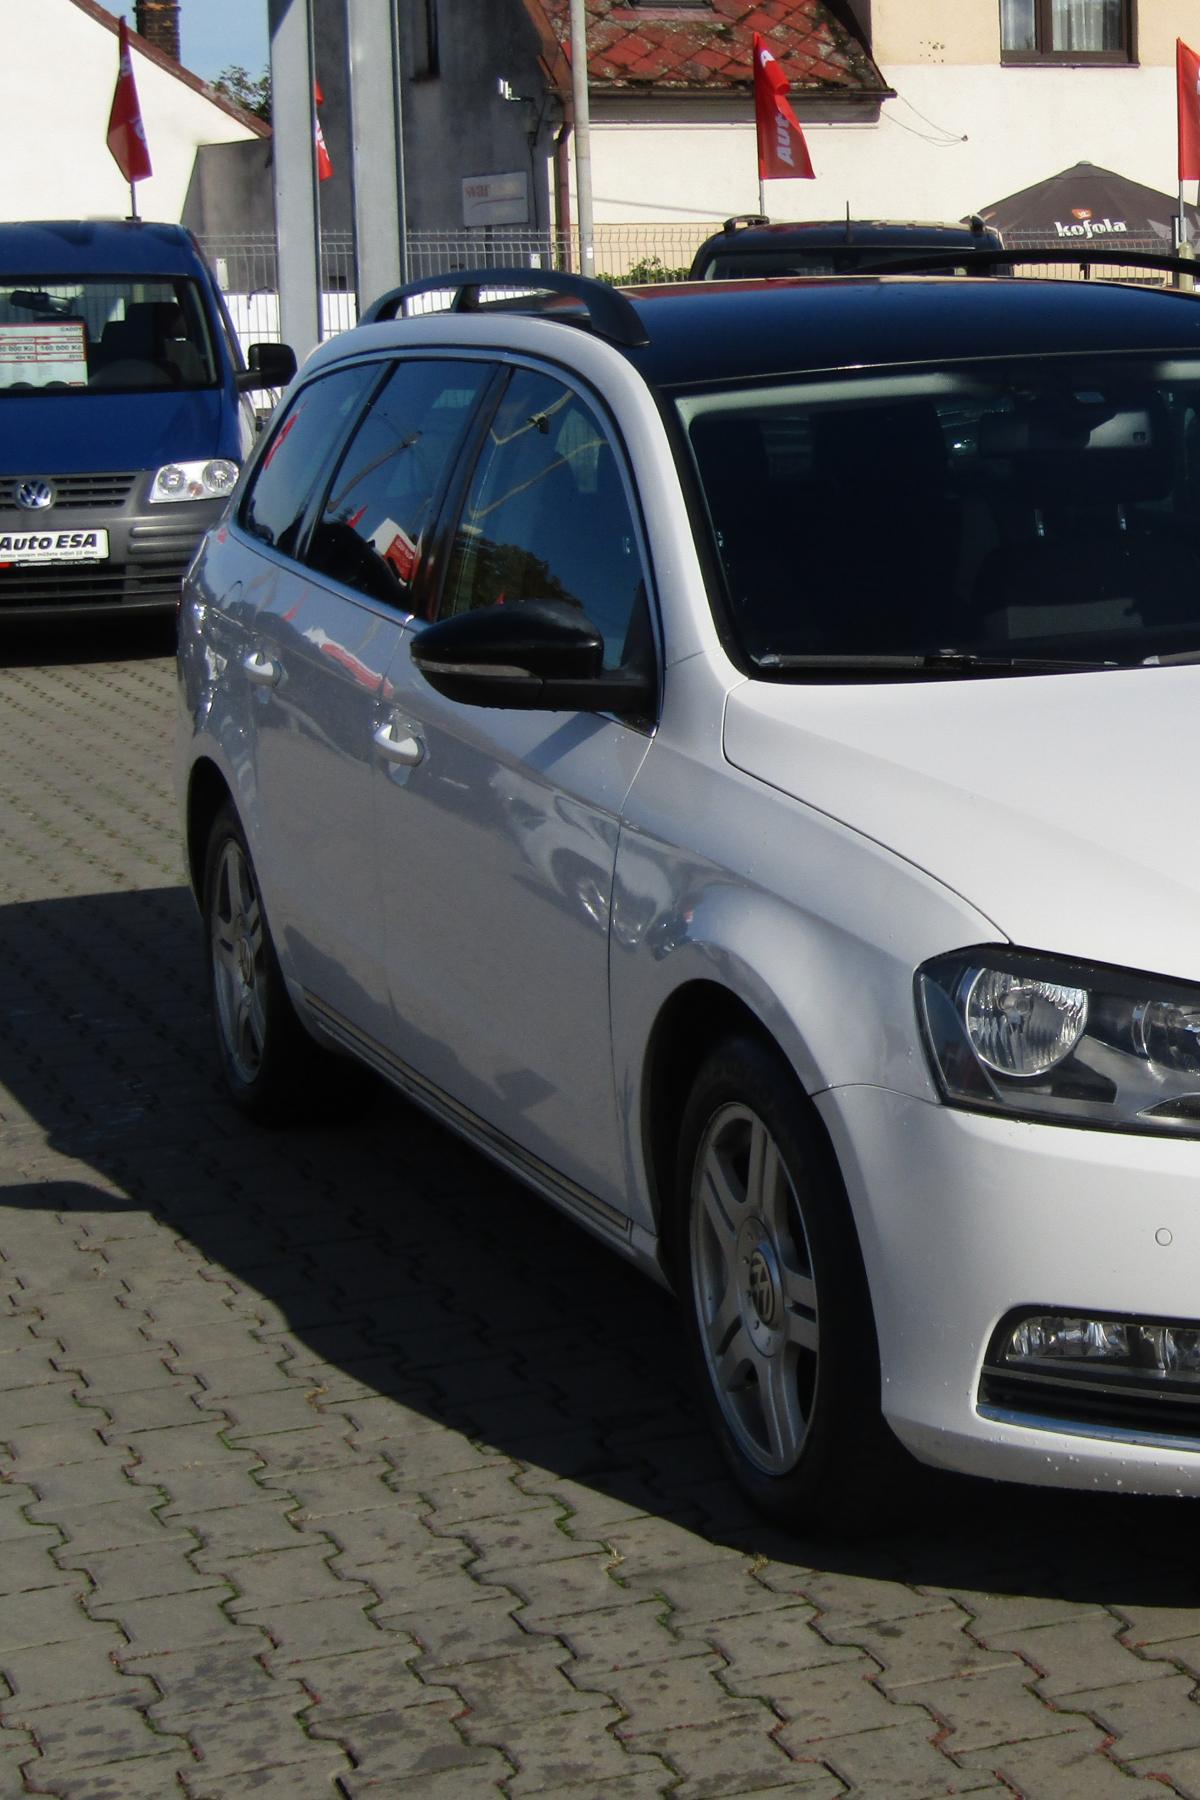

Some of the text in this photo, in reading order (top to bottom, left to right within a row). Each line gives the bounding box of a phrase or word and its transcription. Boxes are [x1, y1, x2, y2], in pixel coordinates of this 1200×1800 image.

[775, 112, 796, 168] Aut
[1054, 218, 1127, 239] kofola
[0, 533, 97, 551] Auto ESA
